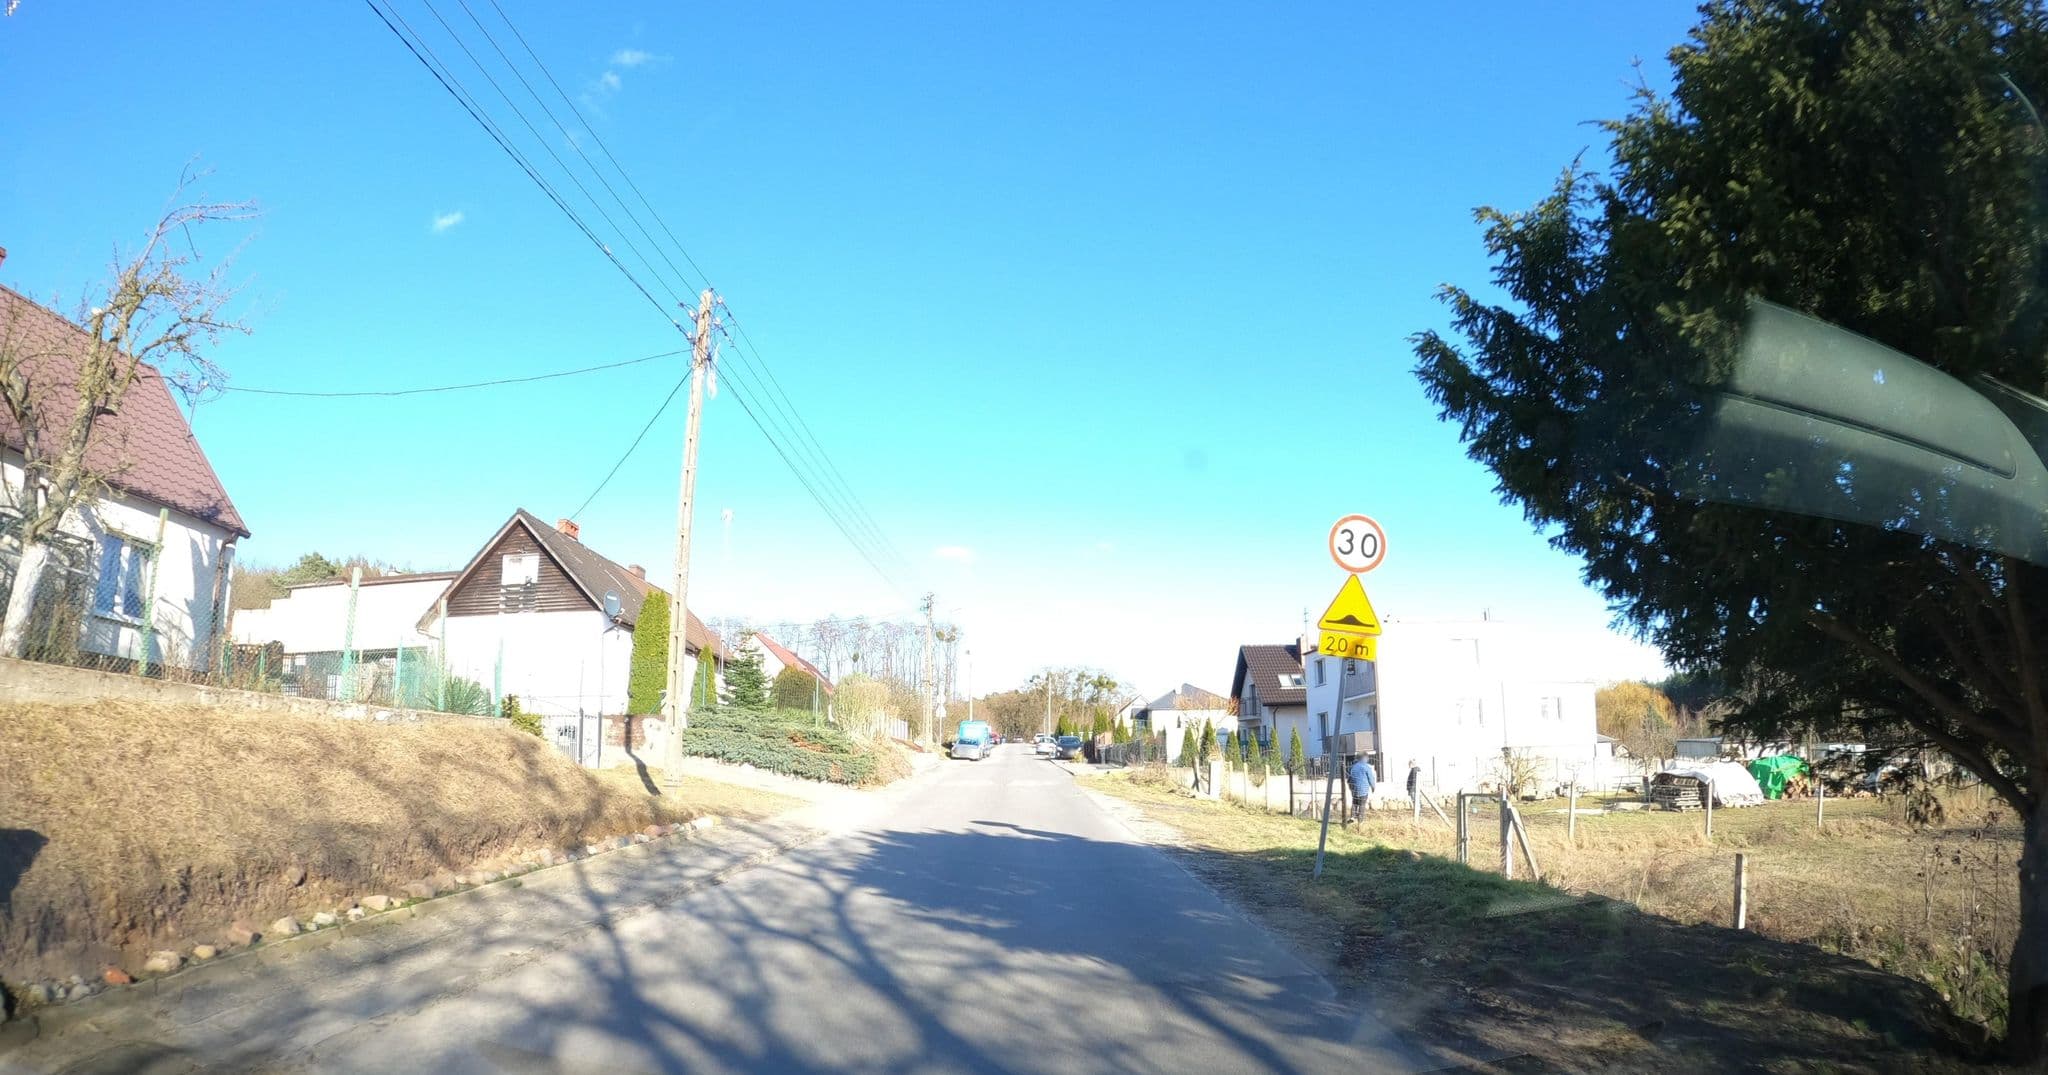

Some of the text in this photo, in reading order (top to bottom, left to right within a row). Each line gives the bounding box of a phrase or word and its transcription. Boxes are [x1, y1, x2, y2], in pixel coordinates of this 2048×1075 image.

[1337, 528, 1378, 559] 30
[1325, 635, 1370, 657] 20 m
